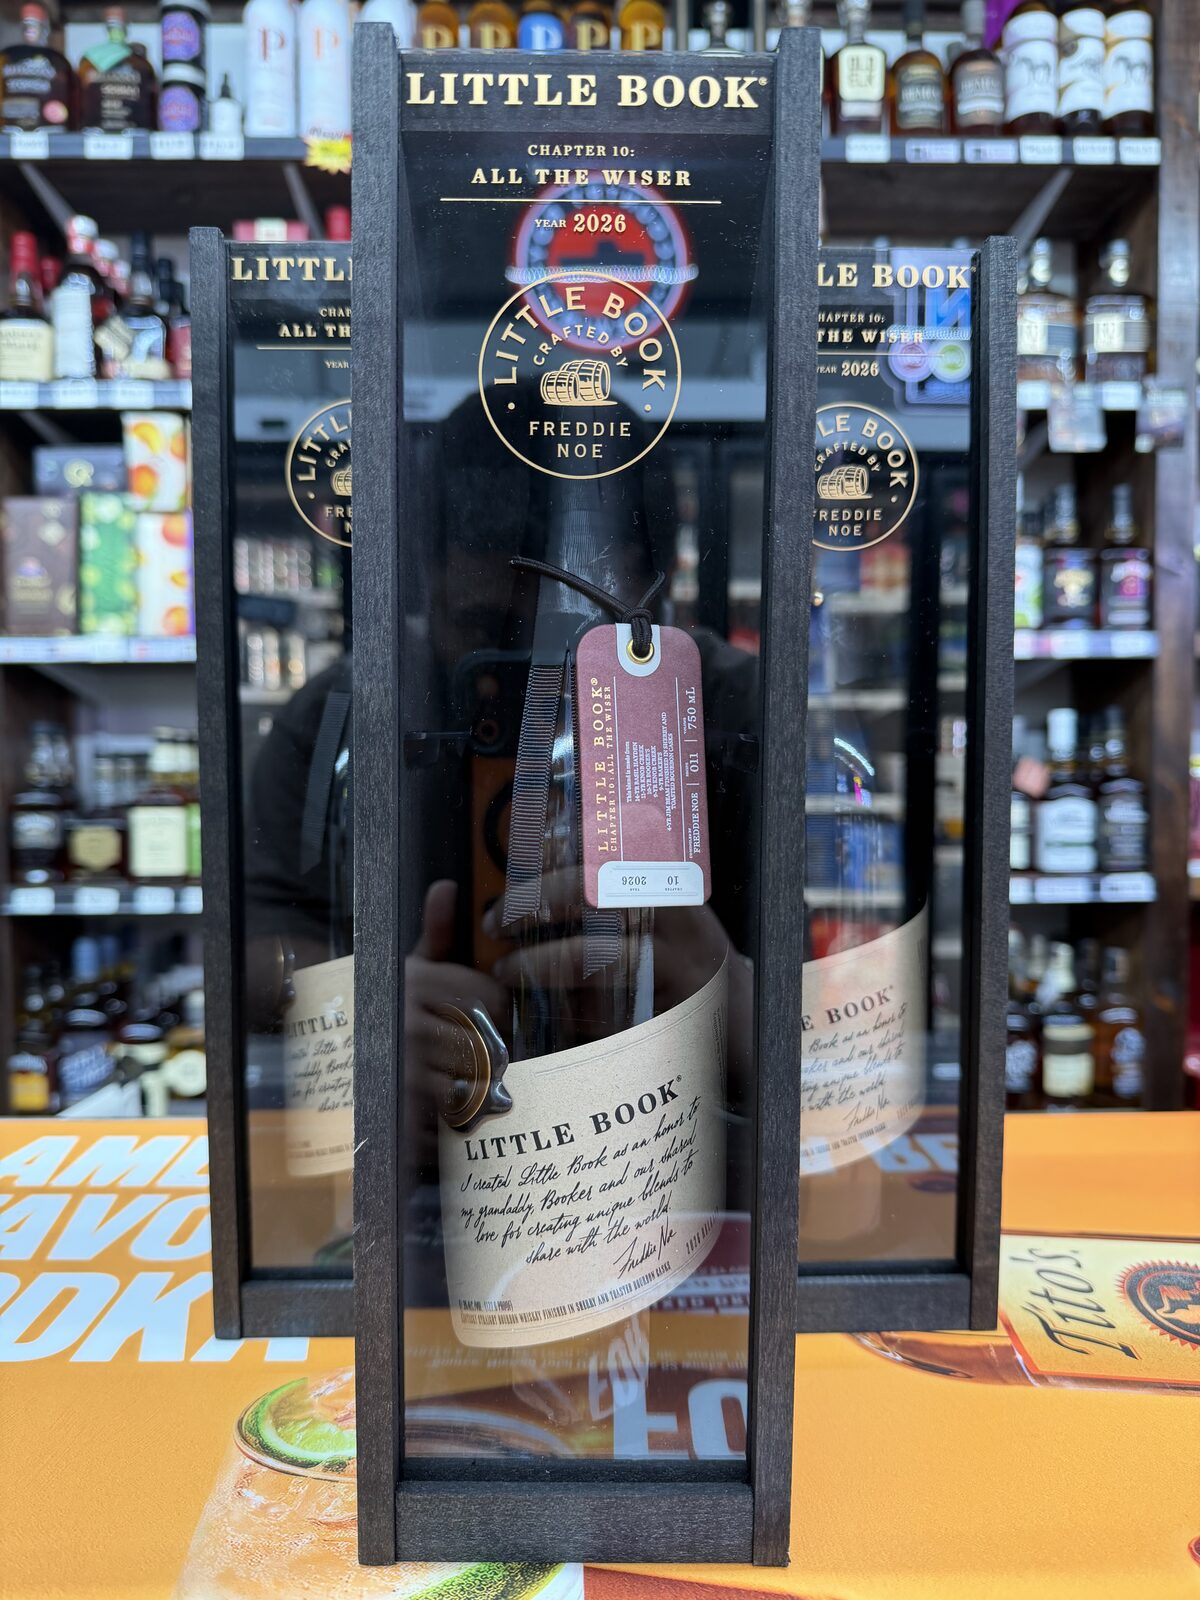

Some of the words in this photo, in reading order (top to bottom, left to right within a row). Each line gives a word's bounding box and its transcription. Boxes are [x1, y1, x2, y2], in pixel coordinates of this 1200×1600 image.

[406, 72, 597, 106] LITTLE
[527, 144, 606, 157] CHAPTER
[612, 145, 635, 158] 10:
[471, 168, 523, 185] ALL
[535, 169, 589, 186] THE
[602, 169, 692, 187] WISER
[534, 218, 567, 229] YEAR
[573, 213, 627, 234] 2026
[231, 257, 352, 281] LITTL
[817, 312, 865, 323] HAPTER
[869, 312, 885, 323] 10:
[279, 323, 317, 337] ALL
[324, 323, 352, 338] TH
[494, 286, 586, 385] LITTLE
[602, 292, 667, 391] BOOK
[861, 328, 924, 344] WISER
[533, 324, 609, 366] CRAFTED
[610, 345, 629, 368] BY
[324, 359, 350, 369] YEAR
[841, 360, 880, 377] 2026
[529, 421, 631, 436] FREDDIE
[296, 409, 353, 481] LITTL
[557, 443, 603, 458] NOE
[814, 440, 868, 472] CRAFTED
[867, 454, 881, 473] BY
[861, 416, 909, 489] BOOK
[813, 510, 882, 521] REDDIE
[828, 525, 863, 537] NOE
[604, 686, 612, 721] WISER
[688, 707, 697, 730] 750
[690, 753, 699, 772] 011
[595, 761, 609, 852] LITTLE
[691, 792, 699, 811] NOE
[609, 799, 617, 852] CHAPTER
[692, 813, 701, 853] FREDDIE
[622, 876, 647, 885] 2026
[667, 876, 679, 885] 10
[808, 1032, 839, 1054] Book
[464, 1122, 575, 1160] LITTLE
[473, 1165, 512, 1192] created
[518, 1162, 561, 1187] Little
[567, 1145, 608, 1176] Book
[613, 1143, 629, 1160] as
[631, 1138, 652, 1151] an
[653, 1112, 685, 1142] honor
[687, 1095, 702, 1121] to
[474, 1192, 535, 1229] grandaddy,
[540, 1181, 593, 1211] Booker
[598, 1160, 631, 1193] and
[633, 1158, 655, 1178] our
[658, 1118, 698, 1164] shared
[475, 1220, 499, 1243] love
[501, 1220, 522, 1248] for
[528, 1212, 582, 1242] creating
[585, 1196, 636, 1227] unique
[638, 1160, 680, 1201] blends
[681, 1148, 700, 1176] to
[526, 1241, 562, 1264] share
[566, 1224, 603, 1255] with
[603, 1216, 631, 1244] the
[634, 1190, 673, 1230] world.
[685, 1231, 701, 1255] 2026
[499, 1313, 519, 1326] BOURBON
[520, 1310, 541, 1323] WHISKEY
[542, 1306, 567, 1321] FINISHED
[568, 1302, 576, 1315] IN
[576, 1296, 597, 1312] SHERRY
[597, 1294, 610, 1307] AND
[610, 1282, 633, 1300] TOASTED
[633, 1270, 656, 1291] BOURBON
[656, 1260, 673, 1277] CASKS
